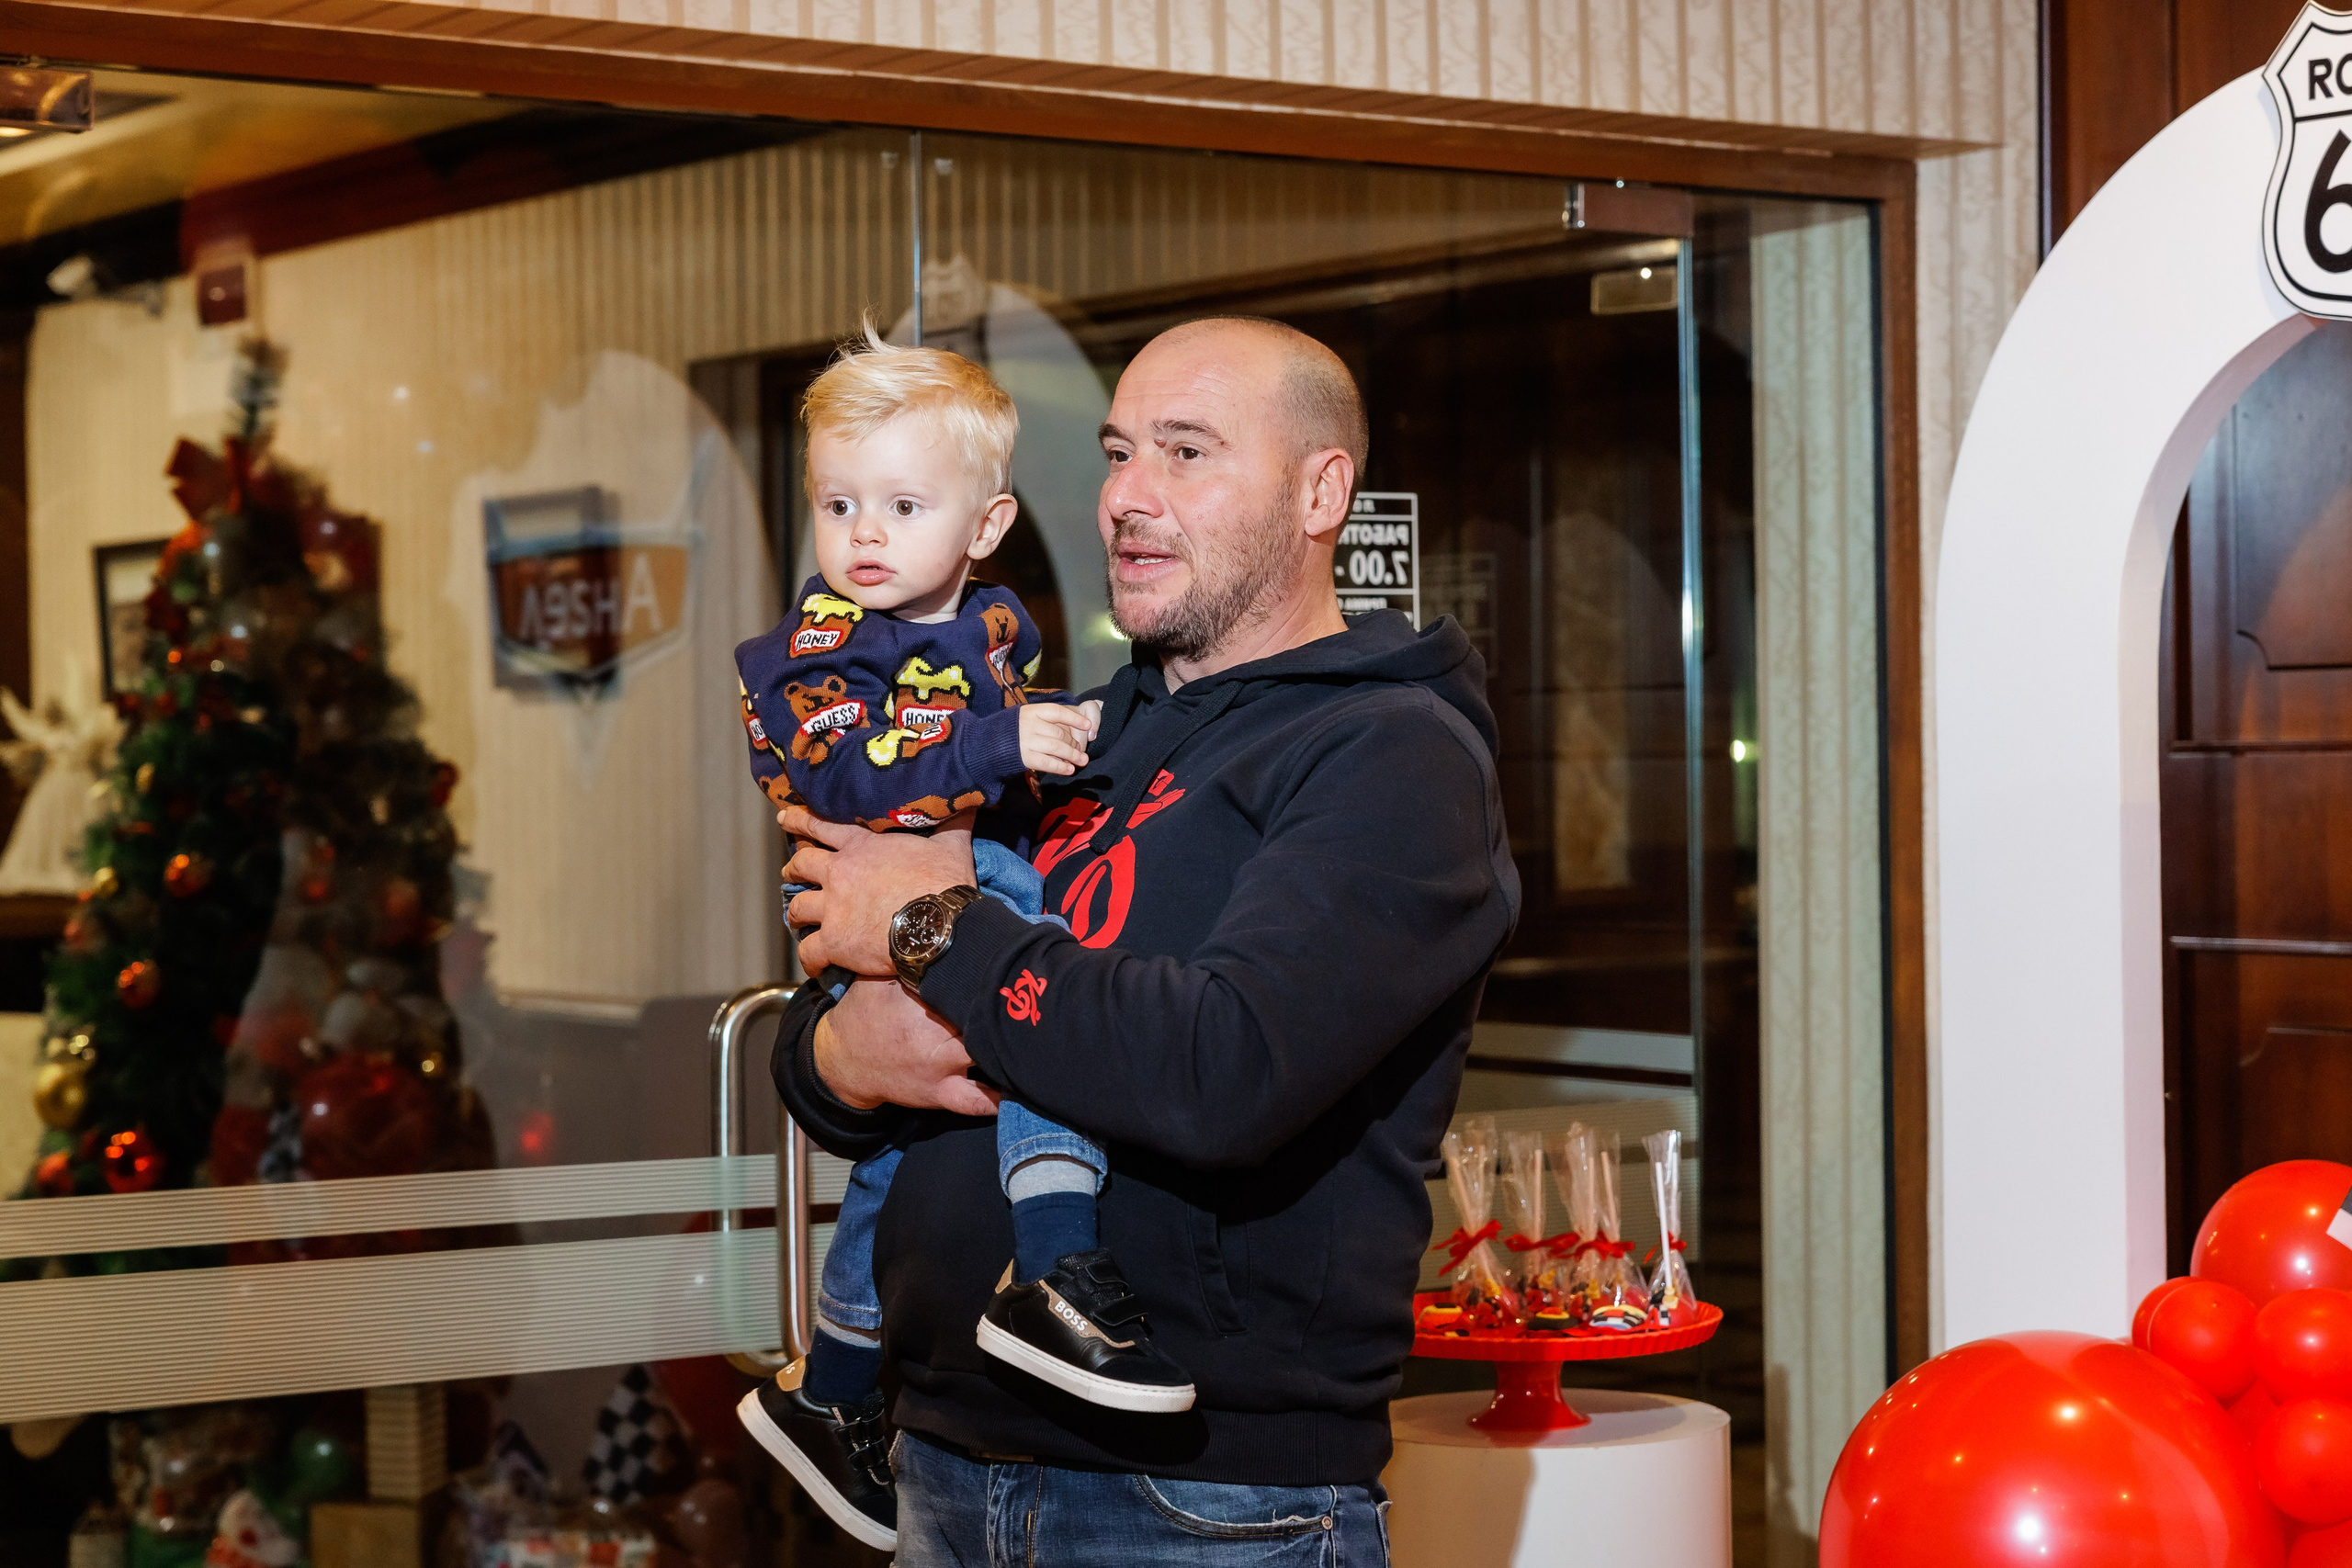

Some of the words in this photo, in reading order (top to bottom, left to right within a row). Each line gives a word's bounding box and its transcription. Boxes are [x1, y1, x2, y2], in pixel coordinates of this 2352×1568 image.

[796, 633, 838, 650] HONEY
[811, 705, 856, 732] GUESS
[906, 712, 948, 725] HONE
[1054, 1300, 1089, 1332] BOSS
